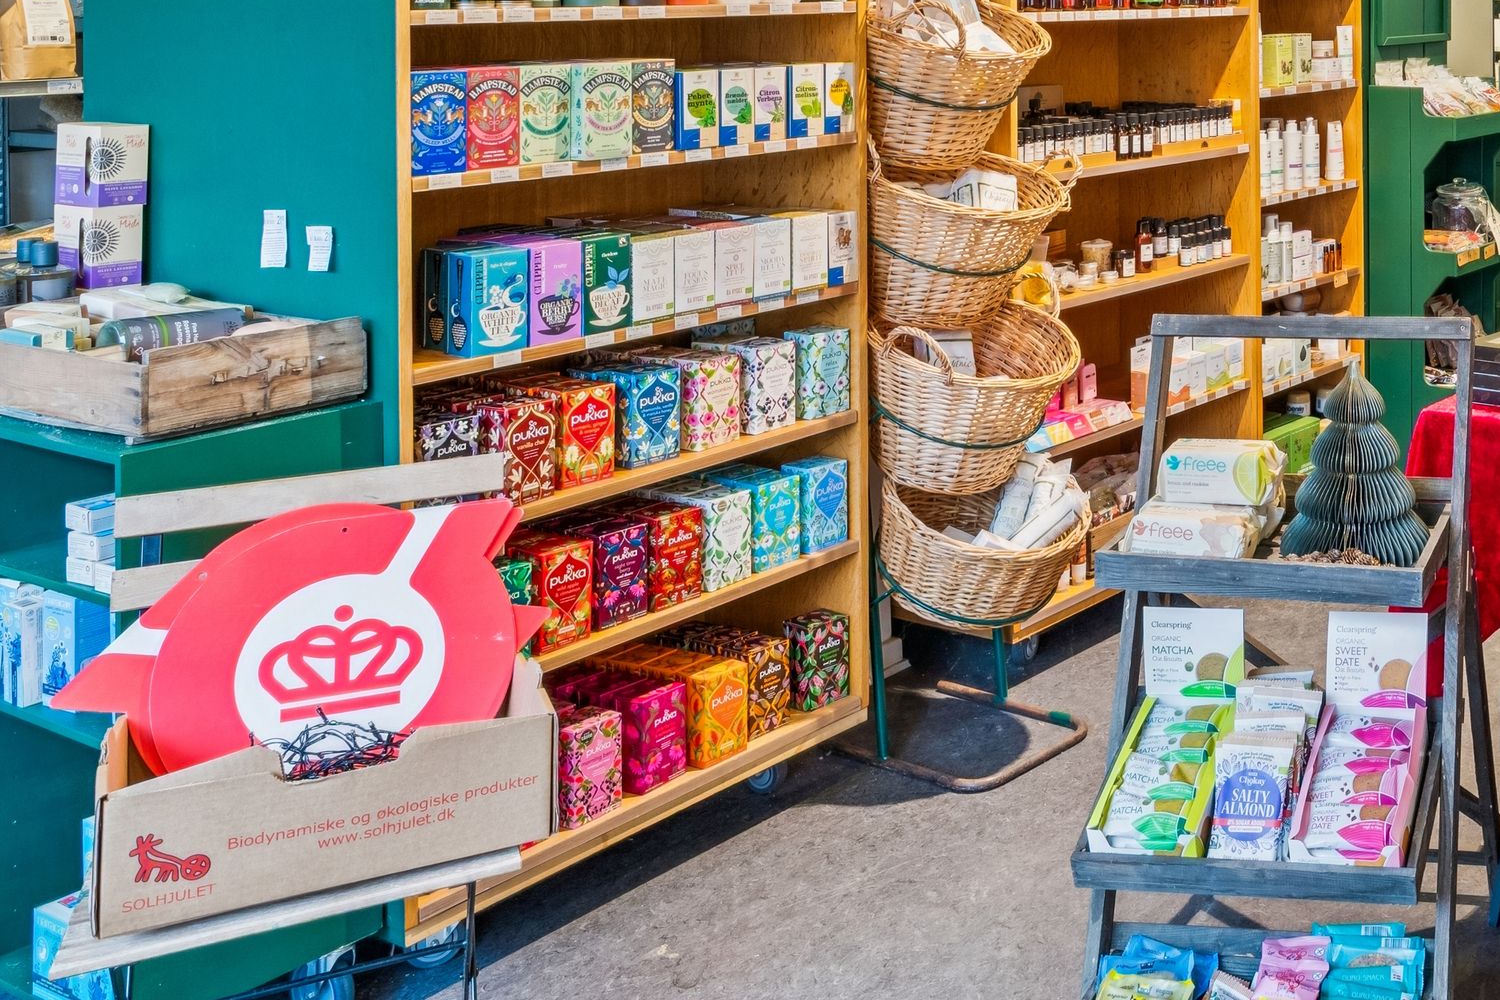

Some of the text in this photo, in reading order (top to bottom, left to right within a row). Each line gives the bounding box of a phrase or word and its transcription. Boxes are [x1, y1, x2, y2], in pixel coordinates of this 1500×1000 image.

[523, 76, 570, 95] HAMPSTEAD
[585, 73, 630, 92] HAMPSTEAD
[634, 71, 674, 89] HAMPSTEAD
[412, 83, 466, 104] HAMPSTEAD
[468, 79, 518, 100] HAMPSTEAD
[759, 89, 781, 97] Citron
[795, 85, 819, 94] Citron-
[795, 91, 819, 99] melisse
[687, 92, 713, 102] Peber-
[687, 99, 714, 109] mynte
[756, 95, 783, 103] Verbena
[533, 249, 543, 295] CLIPPER
[584, 243, 593, 288] CLIPPER
[475, 257, 484, 305] CLIPPER
[540, 298, 574, 309] ORGANIC
[591, 292, 623, 303] ORGANIC
[594, 298, 622, 309] DECAF
[480, 309, 517, 321] ORGANIC
[541, 305, 573, 318] BERRY
[482, 316, 516, 329] WHITE
[490, 324, 511, 336] TEA
[821, 350, 843, 361] pukka
[709, 376, 733, 388] pukka
[639, 390, 675, 409] pukka
[570, 408, 609, 427] pukka
[512, 426, 550, 445] pukka
[437, 442, 467, 457] pukka
[1182, 456, 1227, 473] freee
[816, 482, 844, 498] pukka
[769, 498, 791, 511] pukka
[1148, 520, 1194, 541] freee
[668, 531, 693, 547] pukka
[612, 549, 638, 563] pukka
[549, 567, 587, 590] pukka
[1150, 620, 1193, 630] Clearspring
[1336, 625, 1378, 635] Clearspring
[819, 638, 841, 652] pukka
[1151, 646, 1194, 655] MATCHA
[1335, 647, 1368, 656] SWEET
[1335, 658, 1360, 667] DATE
[759, 663, 782, 679] pukka
[711, 687, 743, 710] pukka
[654, 710, 678, 728] pukka
[586, 740, 612, 758] pukka
[1125, 772, 1160, 785] MATCHA
[1238, 776, 1267, 787] Chokay
[1231, 788, 1270, 803] SALTY
[227, 774, 539, 851] Biodynamiske og økologiske produkter
[1111, 806, 1143, 814] MATCHA
[1220, 801, 1275, 818] ALMOND
[1312, 814, 1341, 822] SWEET
[317, 809, 457, 850] www.solhjulet.dk
[1311, 822, 1332, 830] DATE
[121, 883, 217, 914] SOLHJULET
